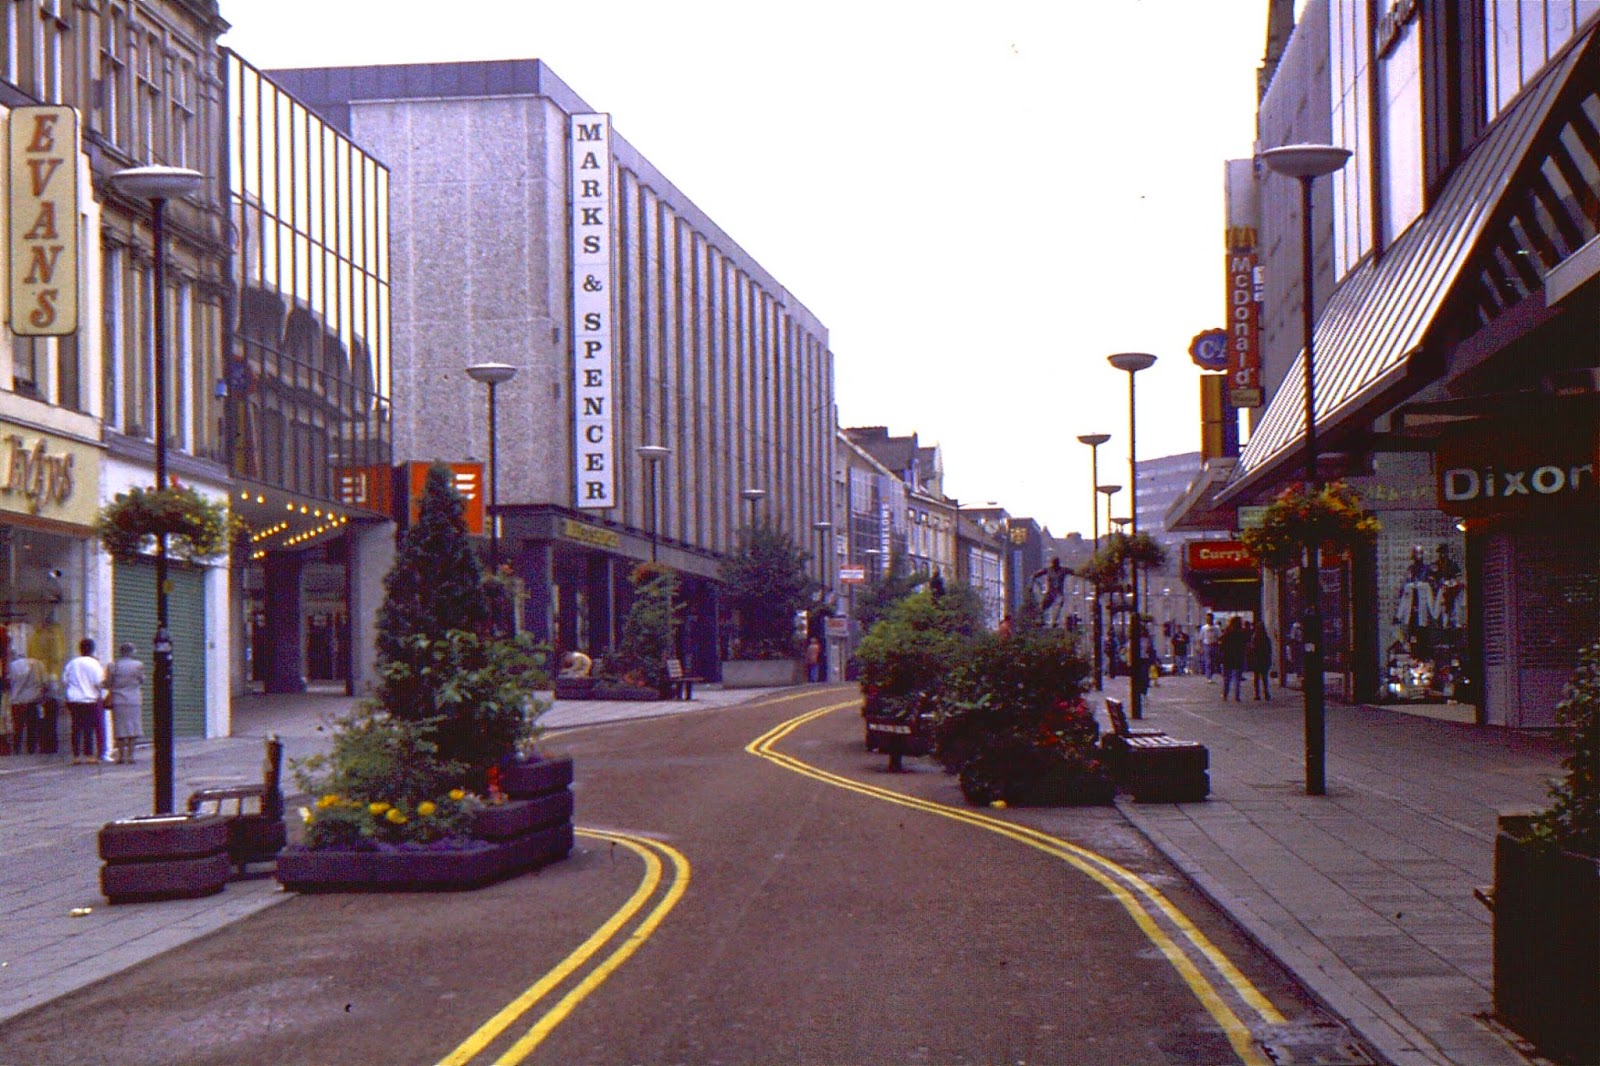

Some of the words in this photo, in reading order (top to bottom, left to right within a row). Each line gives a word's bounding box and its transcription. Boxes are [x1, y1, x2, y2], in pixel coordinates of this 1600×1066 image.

[23, 113, 63, 329] EVANS
[576, 123, 603, 254] MARKS
[583, 273, 603, 293] &
[584, 312, 605, 500] SPENCER
